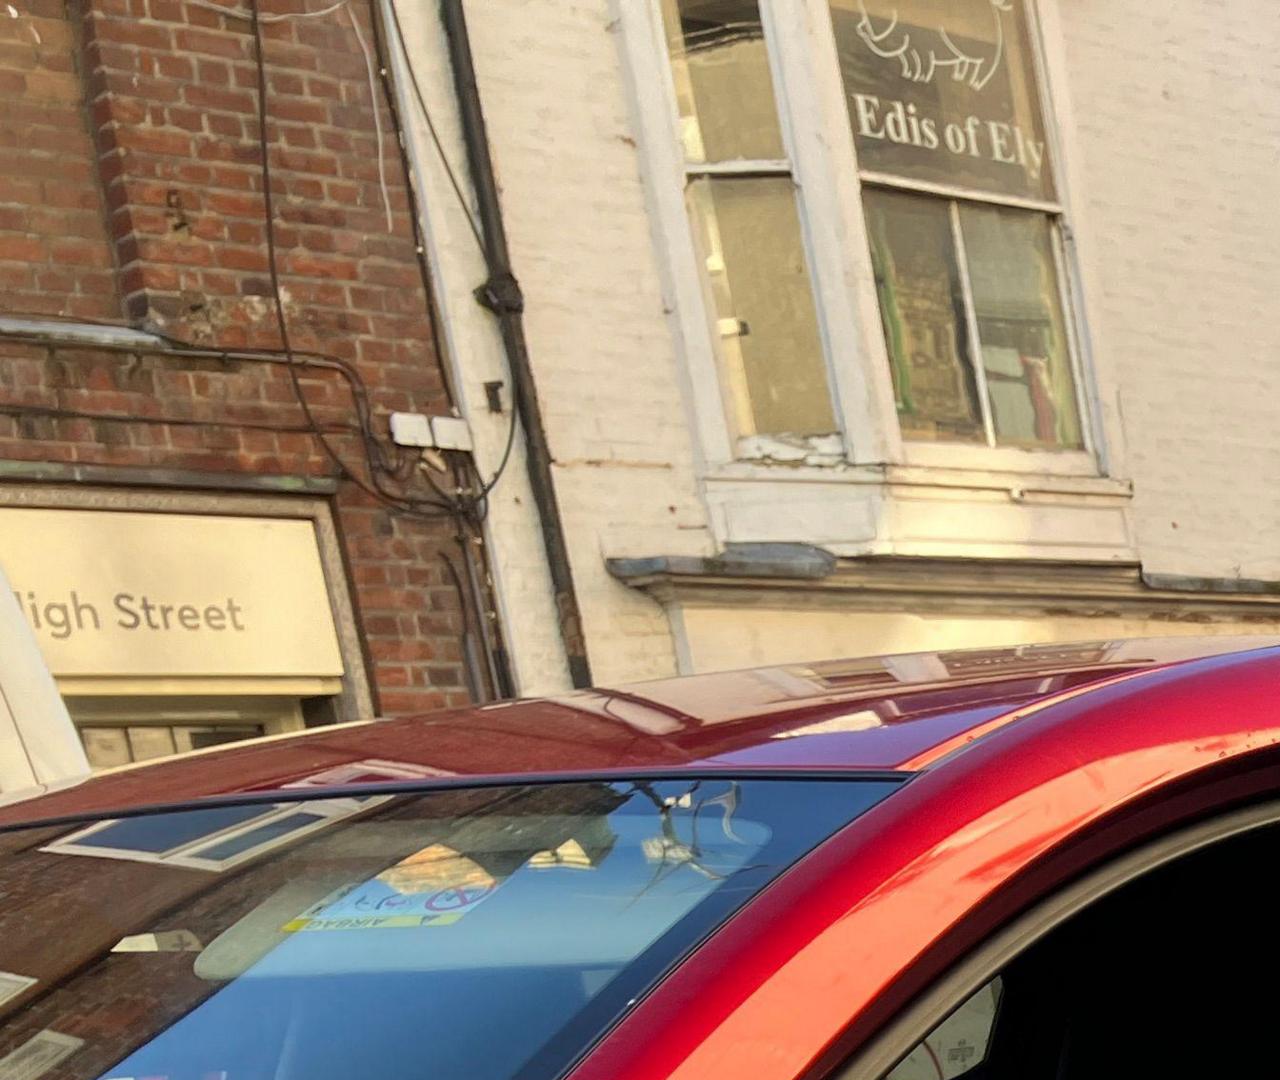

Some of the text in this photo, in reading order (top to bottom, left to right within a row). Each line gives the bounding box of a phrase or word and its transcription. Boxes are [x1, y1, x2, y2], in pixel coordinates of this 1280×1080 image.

[852, 93, 1044, 178] Edis of Ely
[113, 593, 245, 631] Street
